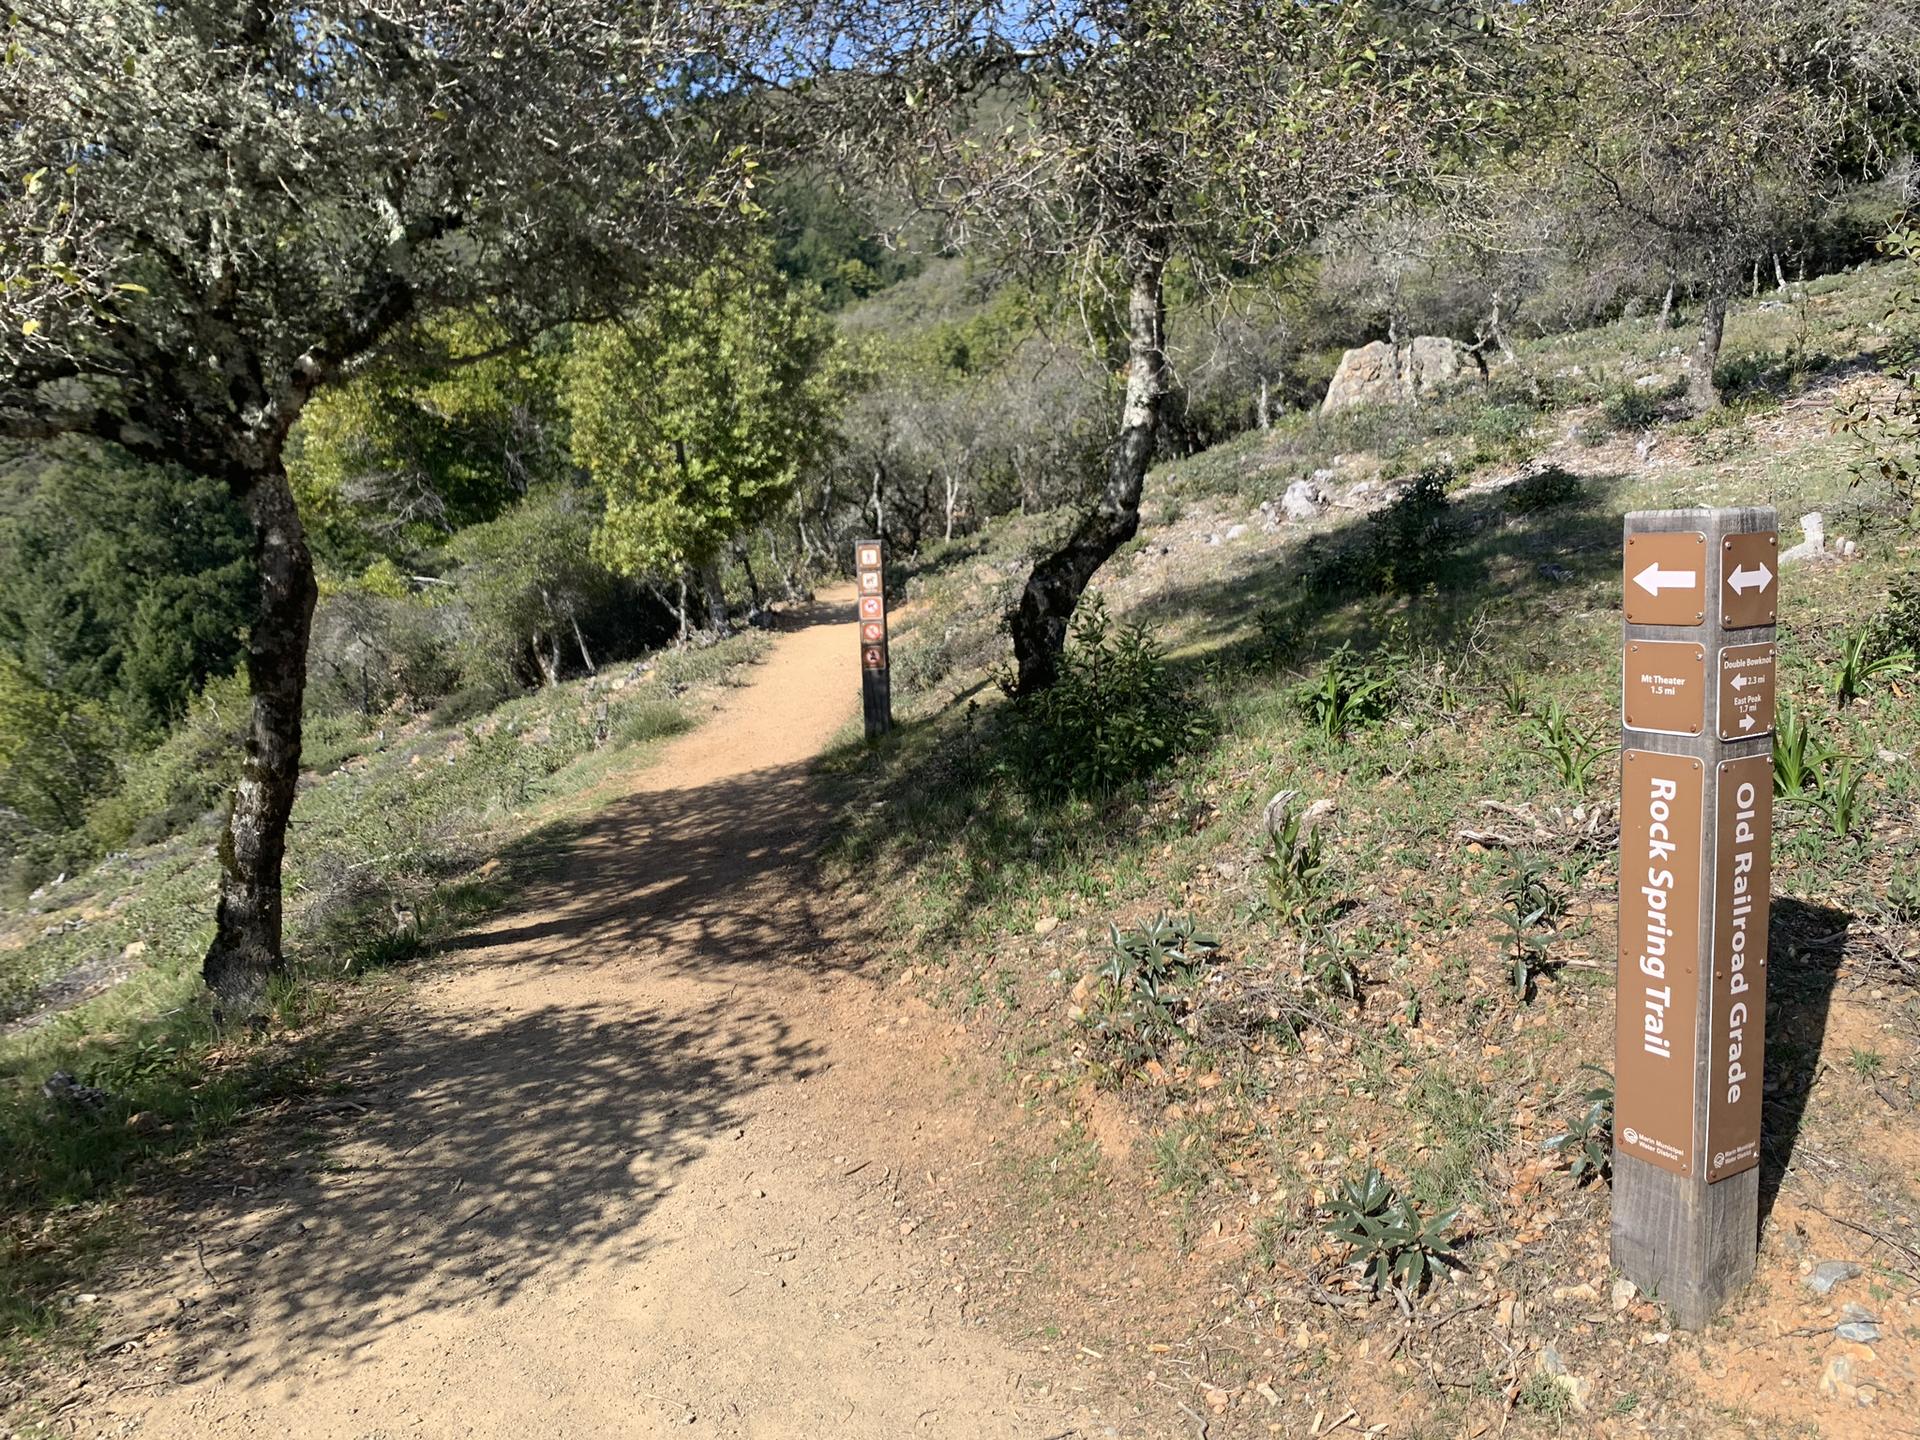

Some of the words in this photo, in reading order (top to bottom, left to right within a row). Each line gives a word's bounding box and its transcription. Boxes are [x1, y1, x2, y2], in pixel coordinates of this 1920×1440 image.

[1724, 659, 1745, 669] Double
[1746, 656, 1772, 666] Bowknot
[1641, 674, 1652, 683] Mt
[1654, 675, 1686, 686] Theater
[1748, 676, 1757, 685] 2.3
[1757, 674, 1766, 683] mi
[1650, 686, 1663, 695] 1.5
[1664, 686, 1675, 695] mi
[1733, 697, 1747, 706] East
[1747, 694, 1762, 704] Peak
[1739, 704, 1749, 713] 1.7
[1749, 703, 1757, 711] mi
[1649, 778, 1676, 861] Rock
[1735, 782, 1755, 843] Old
[1640, 867, 1674, 979] Spring
[1730, 852, 1752, 995] Railroad
[1644, 986, 1671, 1058] Trail
[1727, 1002, 1747, 1104] Grade
[1638, 1134, 1655, 1145] Marin
[1655, 1139, 1684, 1156] Municipal
[1638, 1141, 1655, 1153] Water
[1656, 1148, 1678, 1161] District
